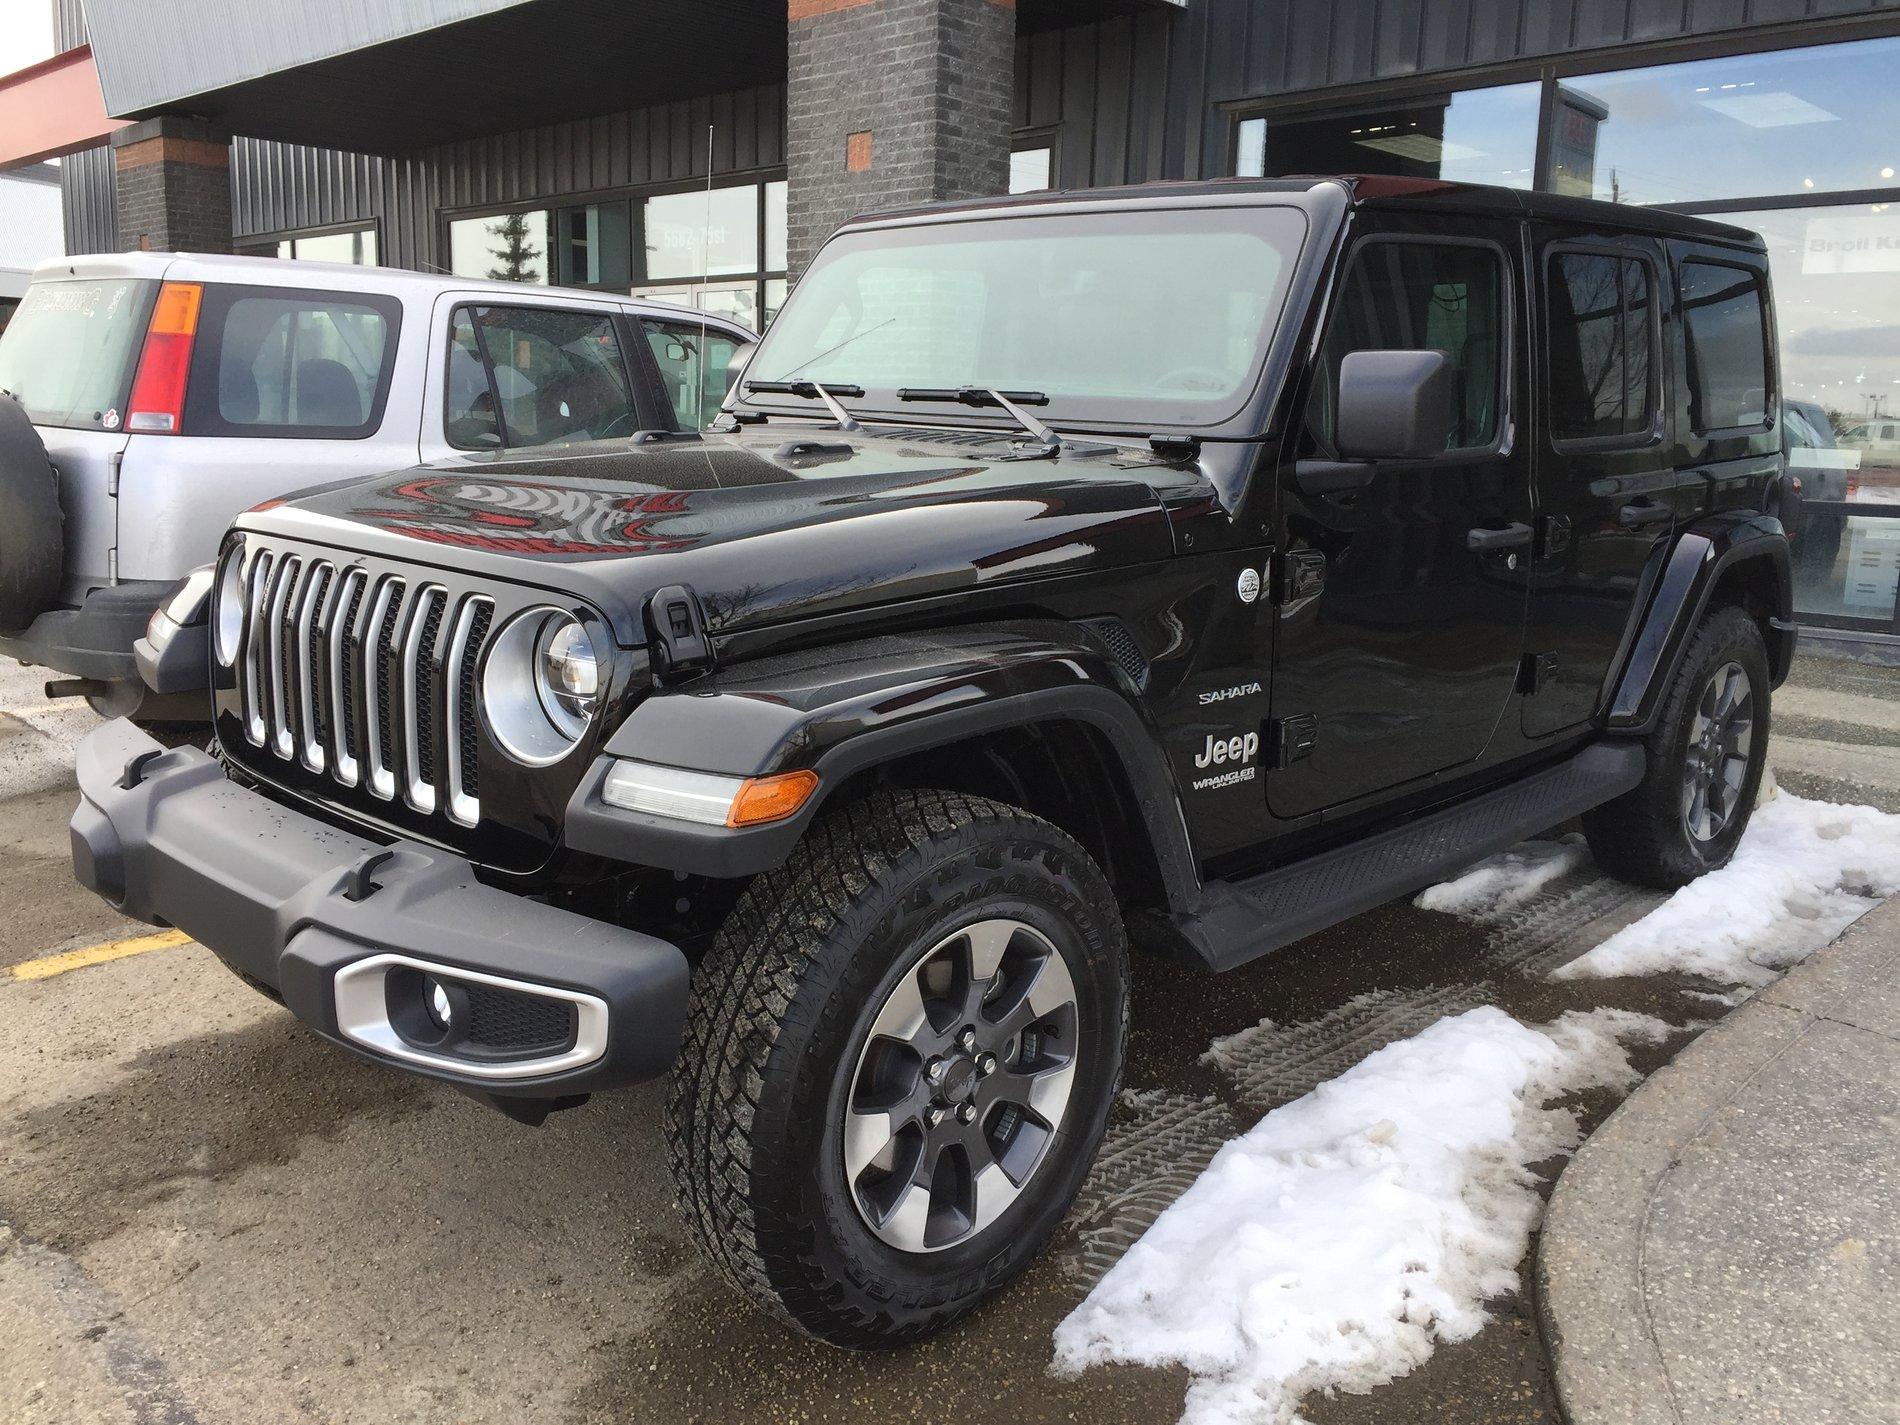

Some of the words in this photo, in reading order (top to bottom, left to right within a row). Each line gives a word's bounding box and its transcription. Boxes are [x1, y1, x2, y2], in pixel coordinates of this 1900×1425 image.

[1198, 682, 1262, 706] SAHARA
[1194, 732, 1259, 768] Jeep
[1192, 767, 1255, 790] WRANGLER
[1212, 775, 1255, 789] UNLIMITED
